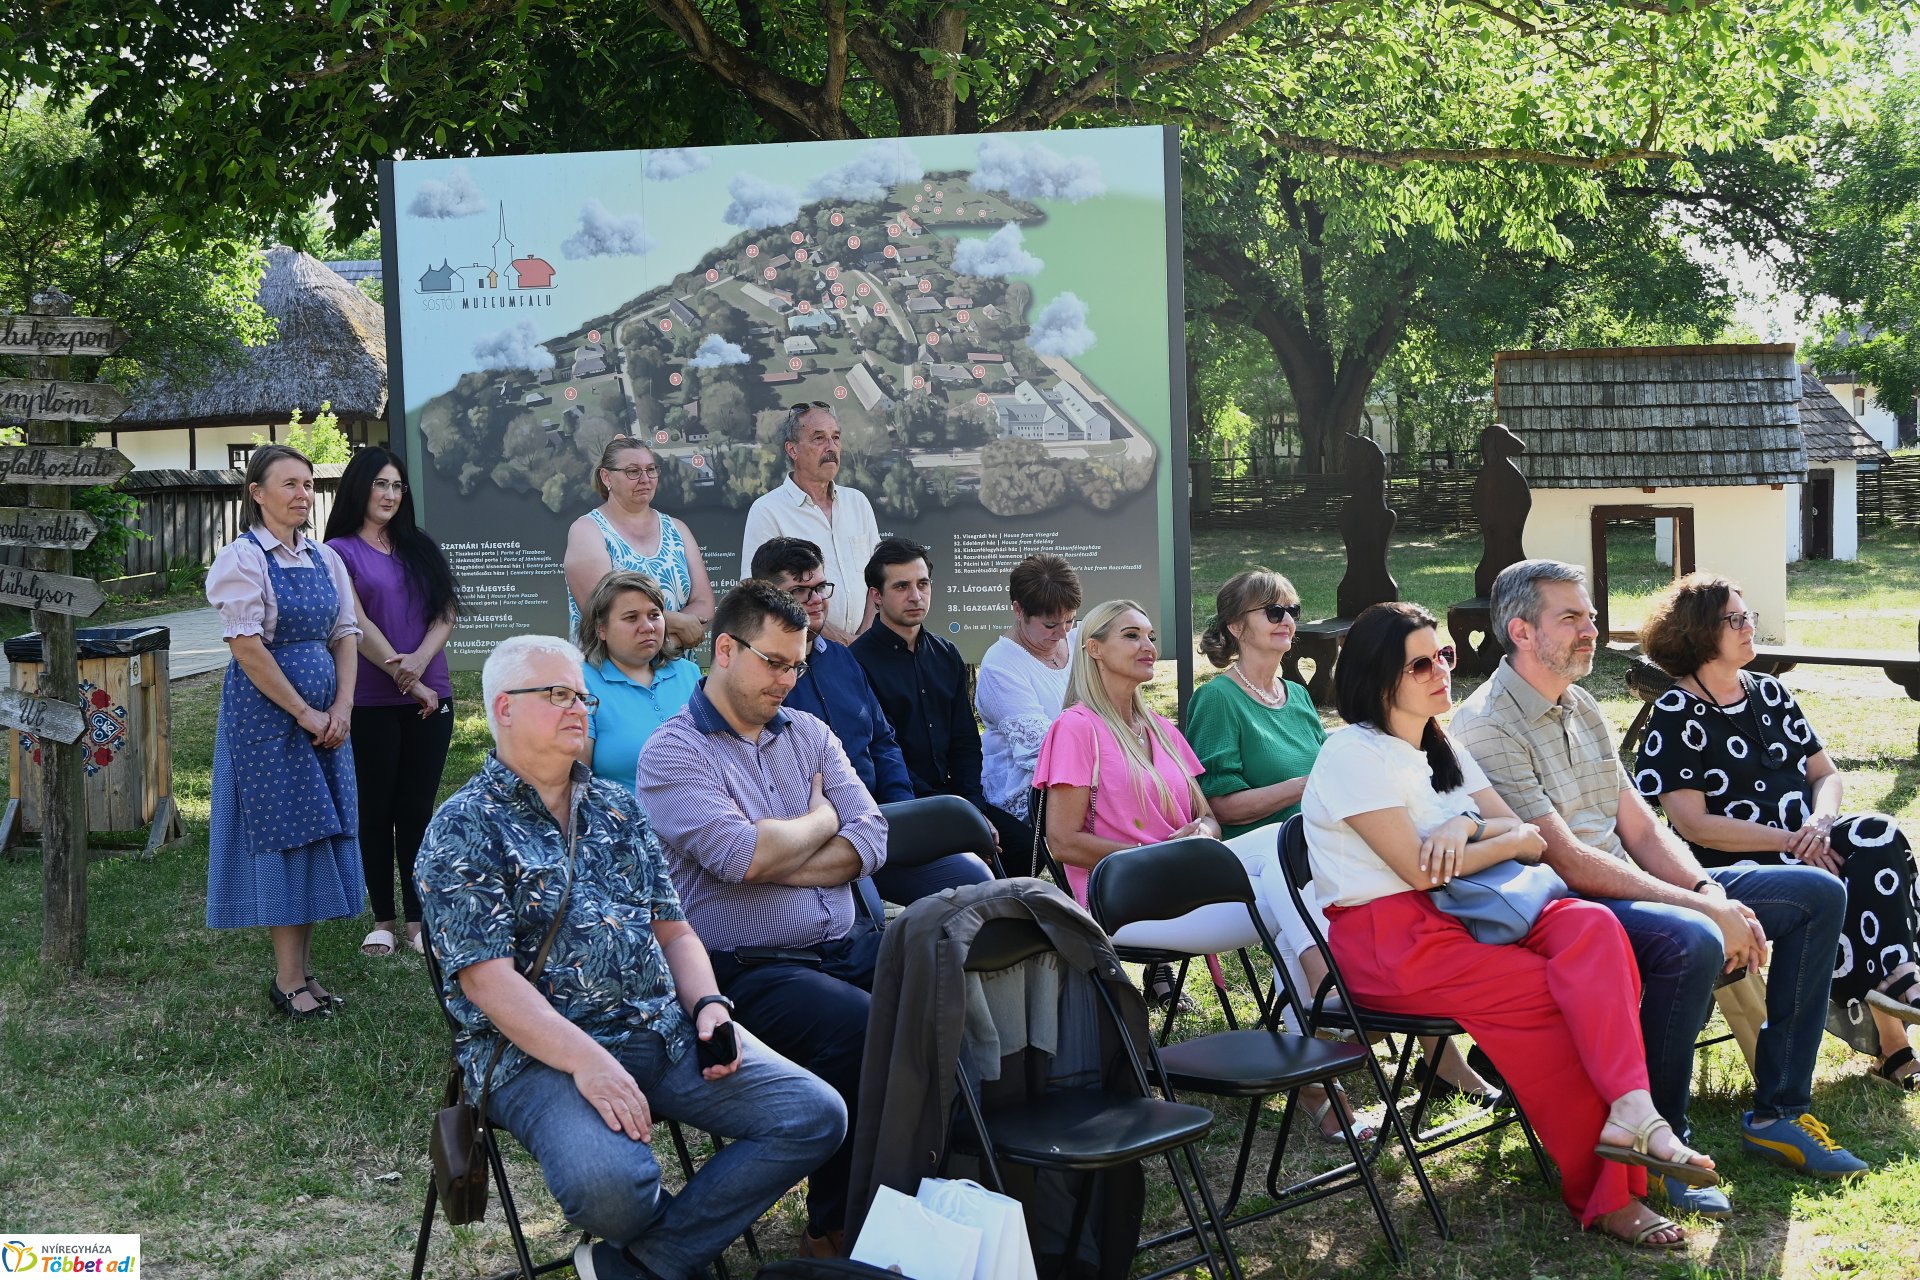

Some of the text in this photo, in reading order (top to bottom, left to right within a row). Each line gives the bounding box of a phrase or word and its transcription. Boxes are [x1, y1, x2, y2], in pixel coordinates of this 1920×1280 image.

[423, 296, 455, 311] SÓSTÓI
[36, 515, 91, 541] raktár
[441, 541, 520, 550] SZATMÁRI TÁJEGYSÉG
[962, 584, 1002, 592] LÁTOGATÓ
[963, 603, 1008, 611] IGAZGATÁSI
